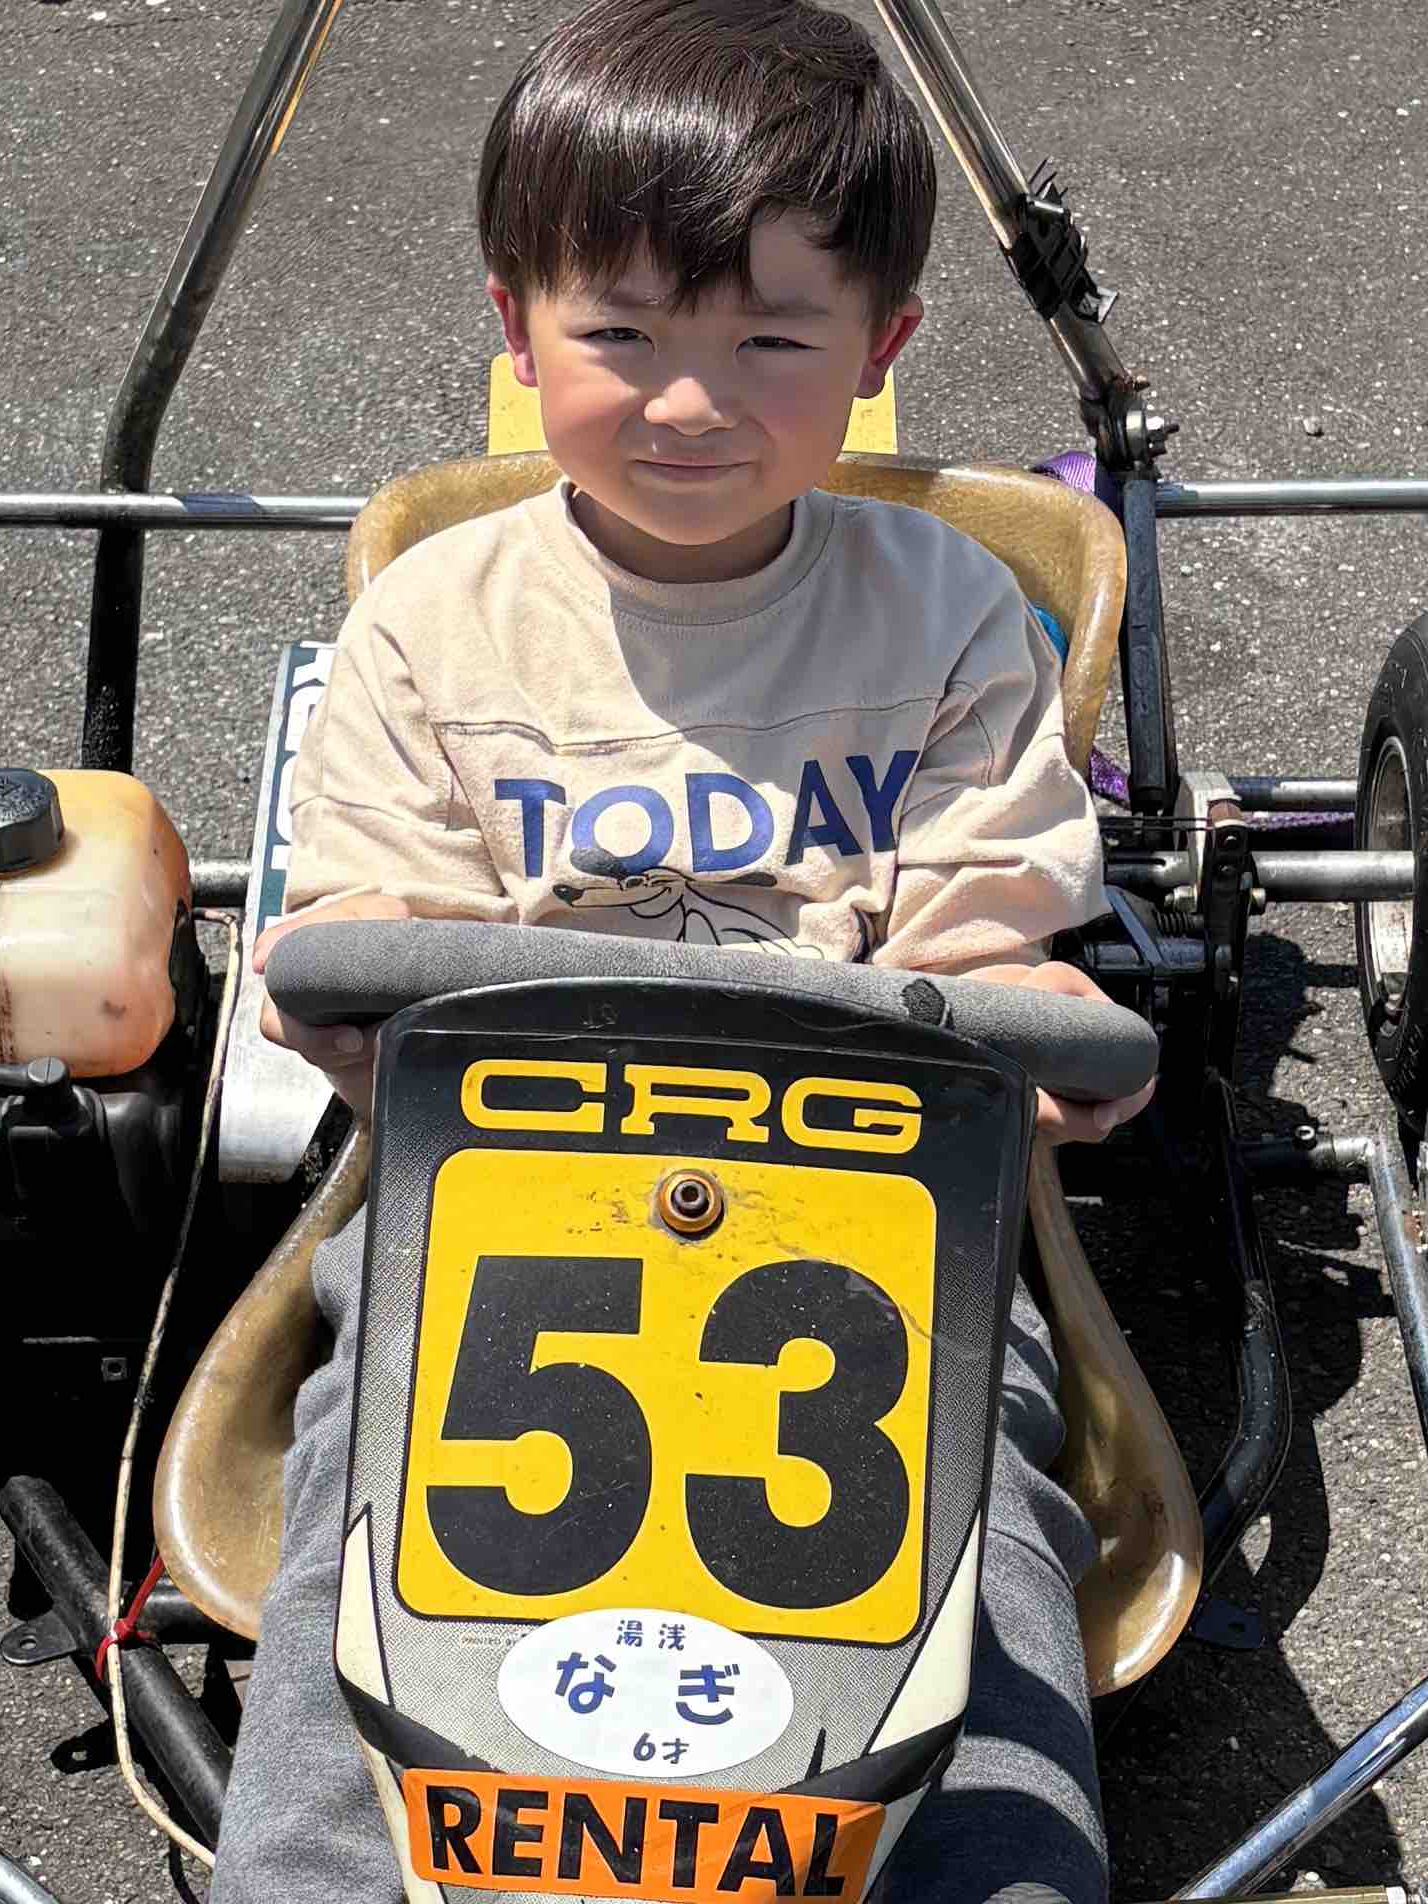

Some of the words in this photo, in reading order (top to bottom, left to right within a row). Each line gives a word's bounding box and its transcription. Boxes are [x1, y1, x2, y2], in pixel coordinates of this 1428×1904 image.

[494, 749, 918, 878] TODAY
[460, 1058, 923, 1154] CRG
[425, 1254, 912, 1610] 53
[616, 1619, 687, 1652] 湯浅
[554, 1651, 741, 1726] なぎ
[632, 1732, 690, 1765] 6才
[427, 1785, 848, 1899] RENTAL
